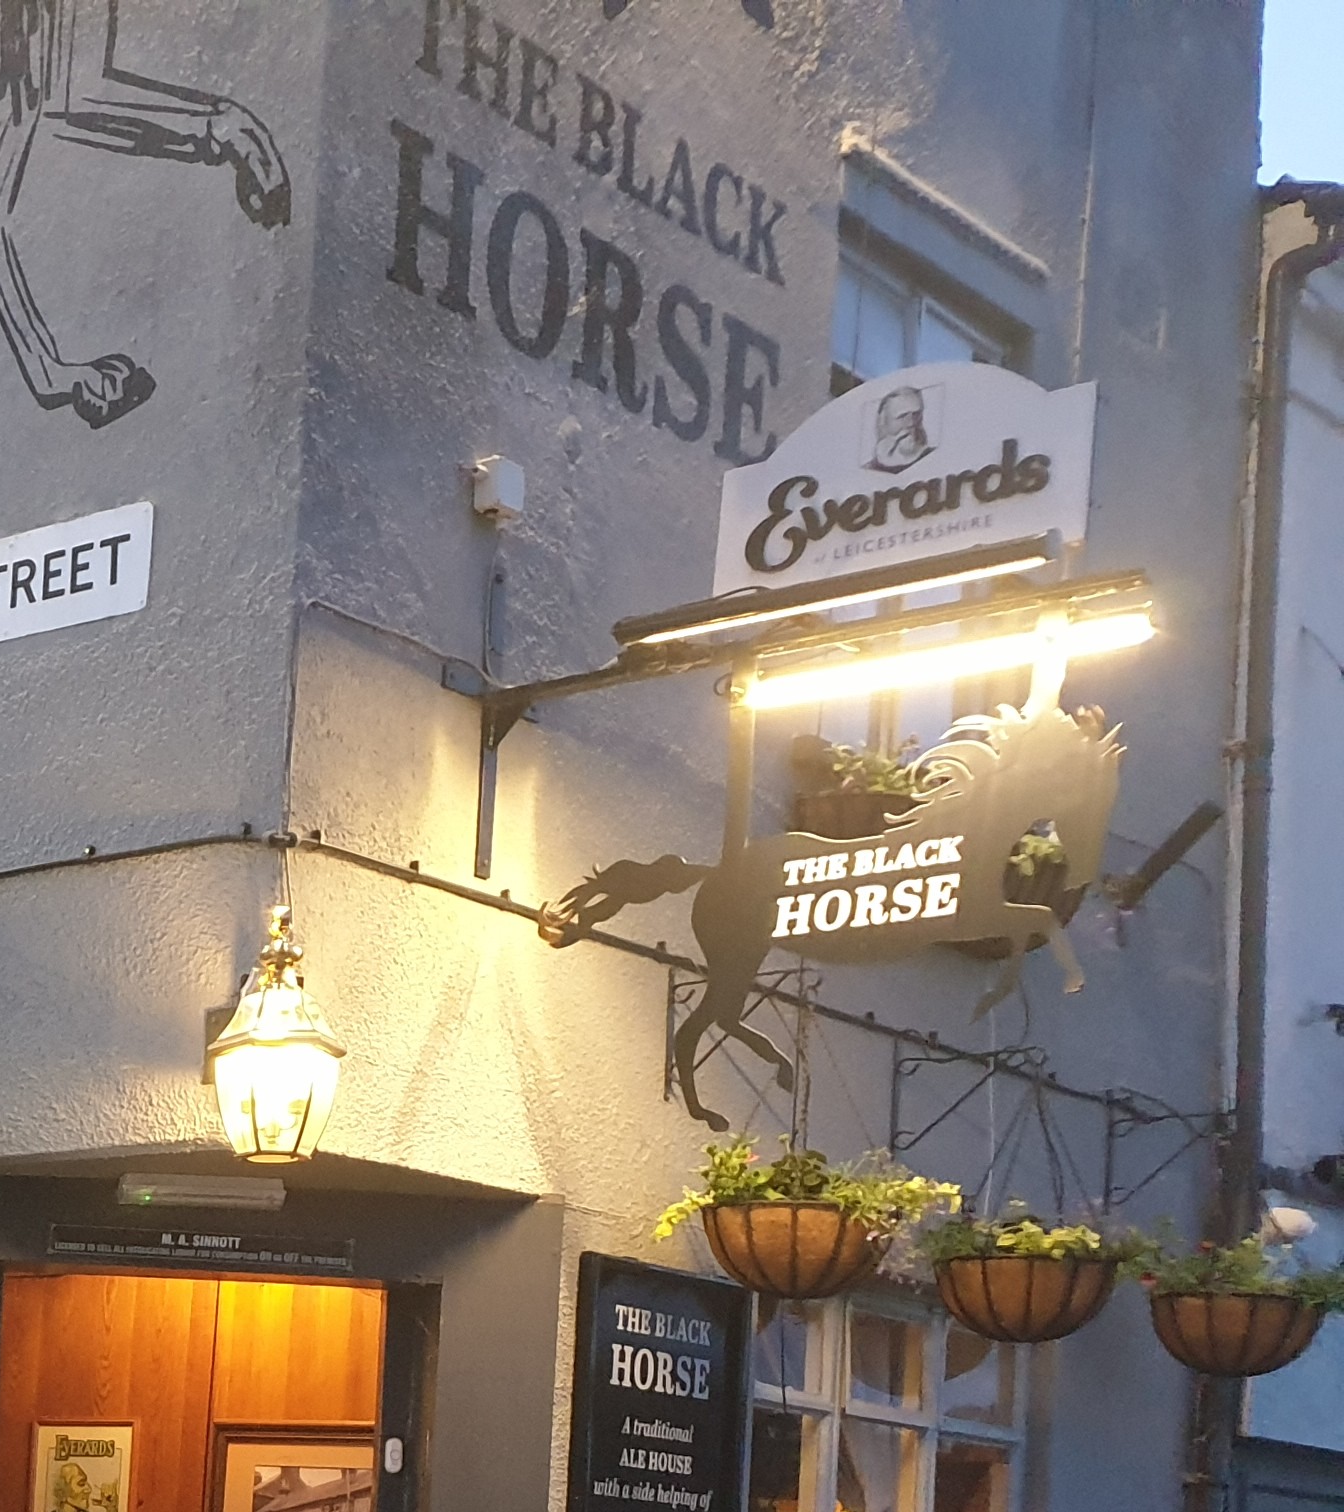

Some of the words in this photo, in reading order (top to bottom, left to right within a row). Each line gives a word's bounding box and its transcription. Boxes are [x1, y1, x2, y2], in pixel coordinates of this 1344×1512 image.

[414, 0, 559, 148] THE
[572, 70, 787, 288] BLACK
[385, 117, 781, 464] HORSE
[744, 438, 1051, 573] Everards
[834, 514, 993, 560] LEICESTERSHIRE
[783, 852, 849, 886] THE
[851, 835, 964, 877] BLACK
[771, 873, 961, 938] HORSE
[192, 1234, 241, 1249] SINNOTT
[616, 1304, 652, 1336] THE
[655, 1312, 711, 1347] BLACK
[610, 1343, 710, 1400] HORSE
[621, 1416, 632, 1435] A
[634, 1417, 694, 1444] traditional
[619, 1448, 646, 1470] ALE
[649, 1451, 692, 1475] HOUSE
[593, 1478, 619, 1499] with
[622, 1486, 630, 1499] a
[632, 1481, 655, 1502] side
[657, 1484, 698, 1511] helping
[700, 1491, 713, 1512] of
